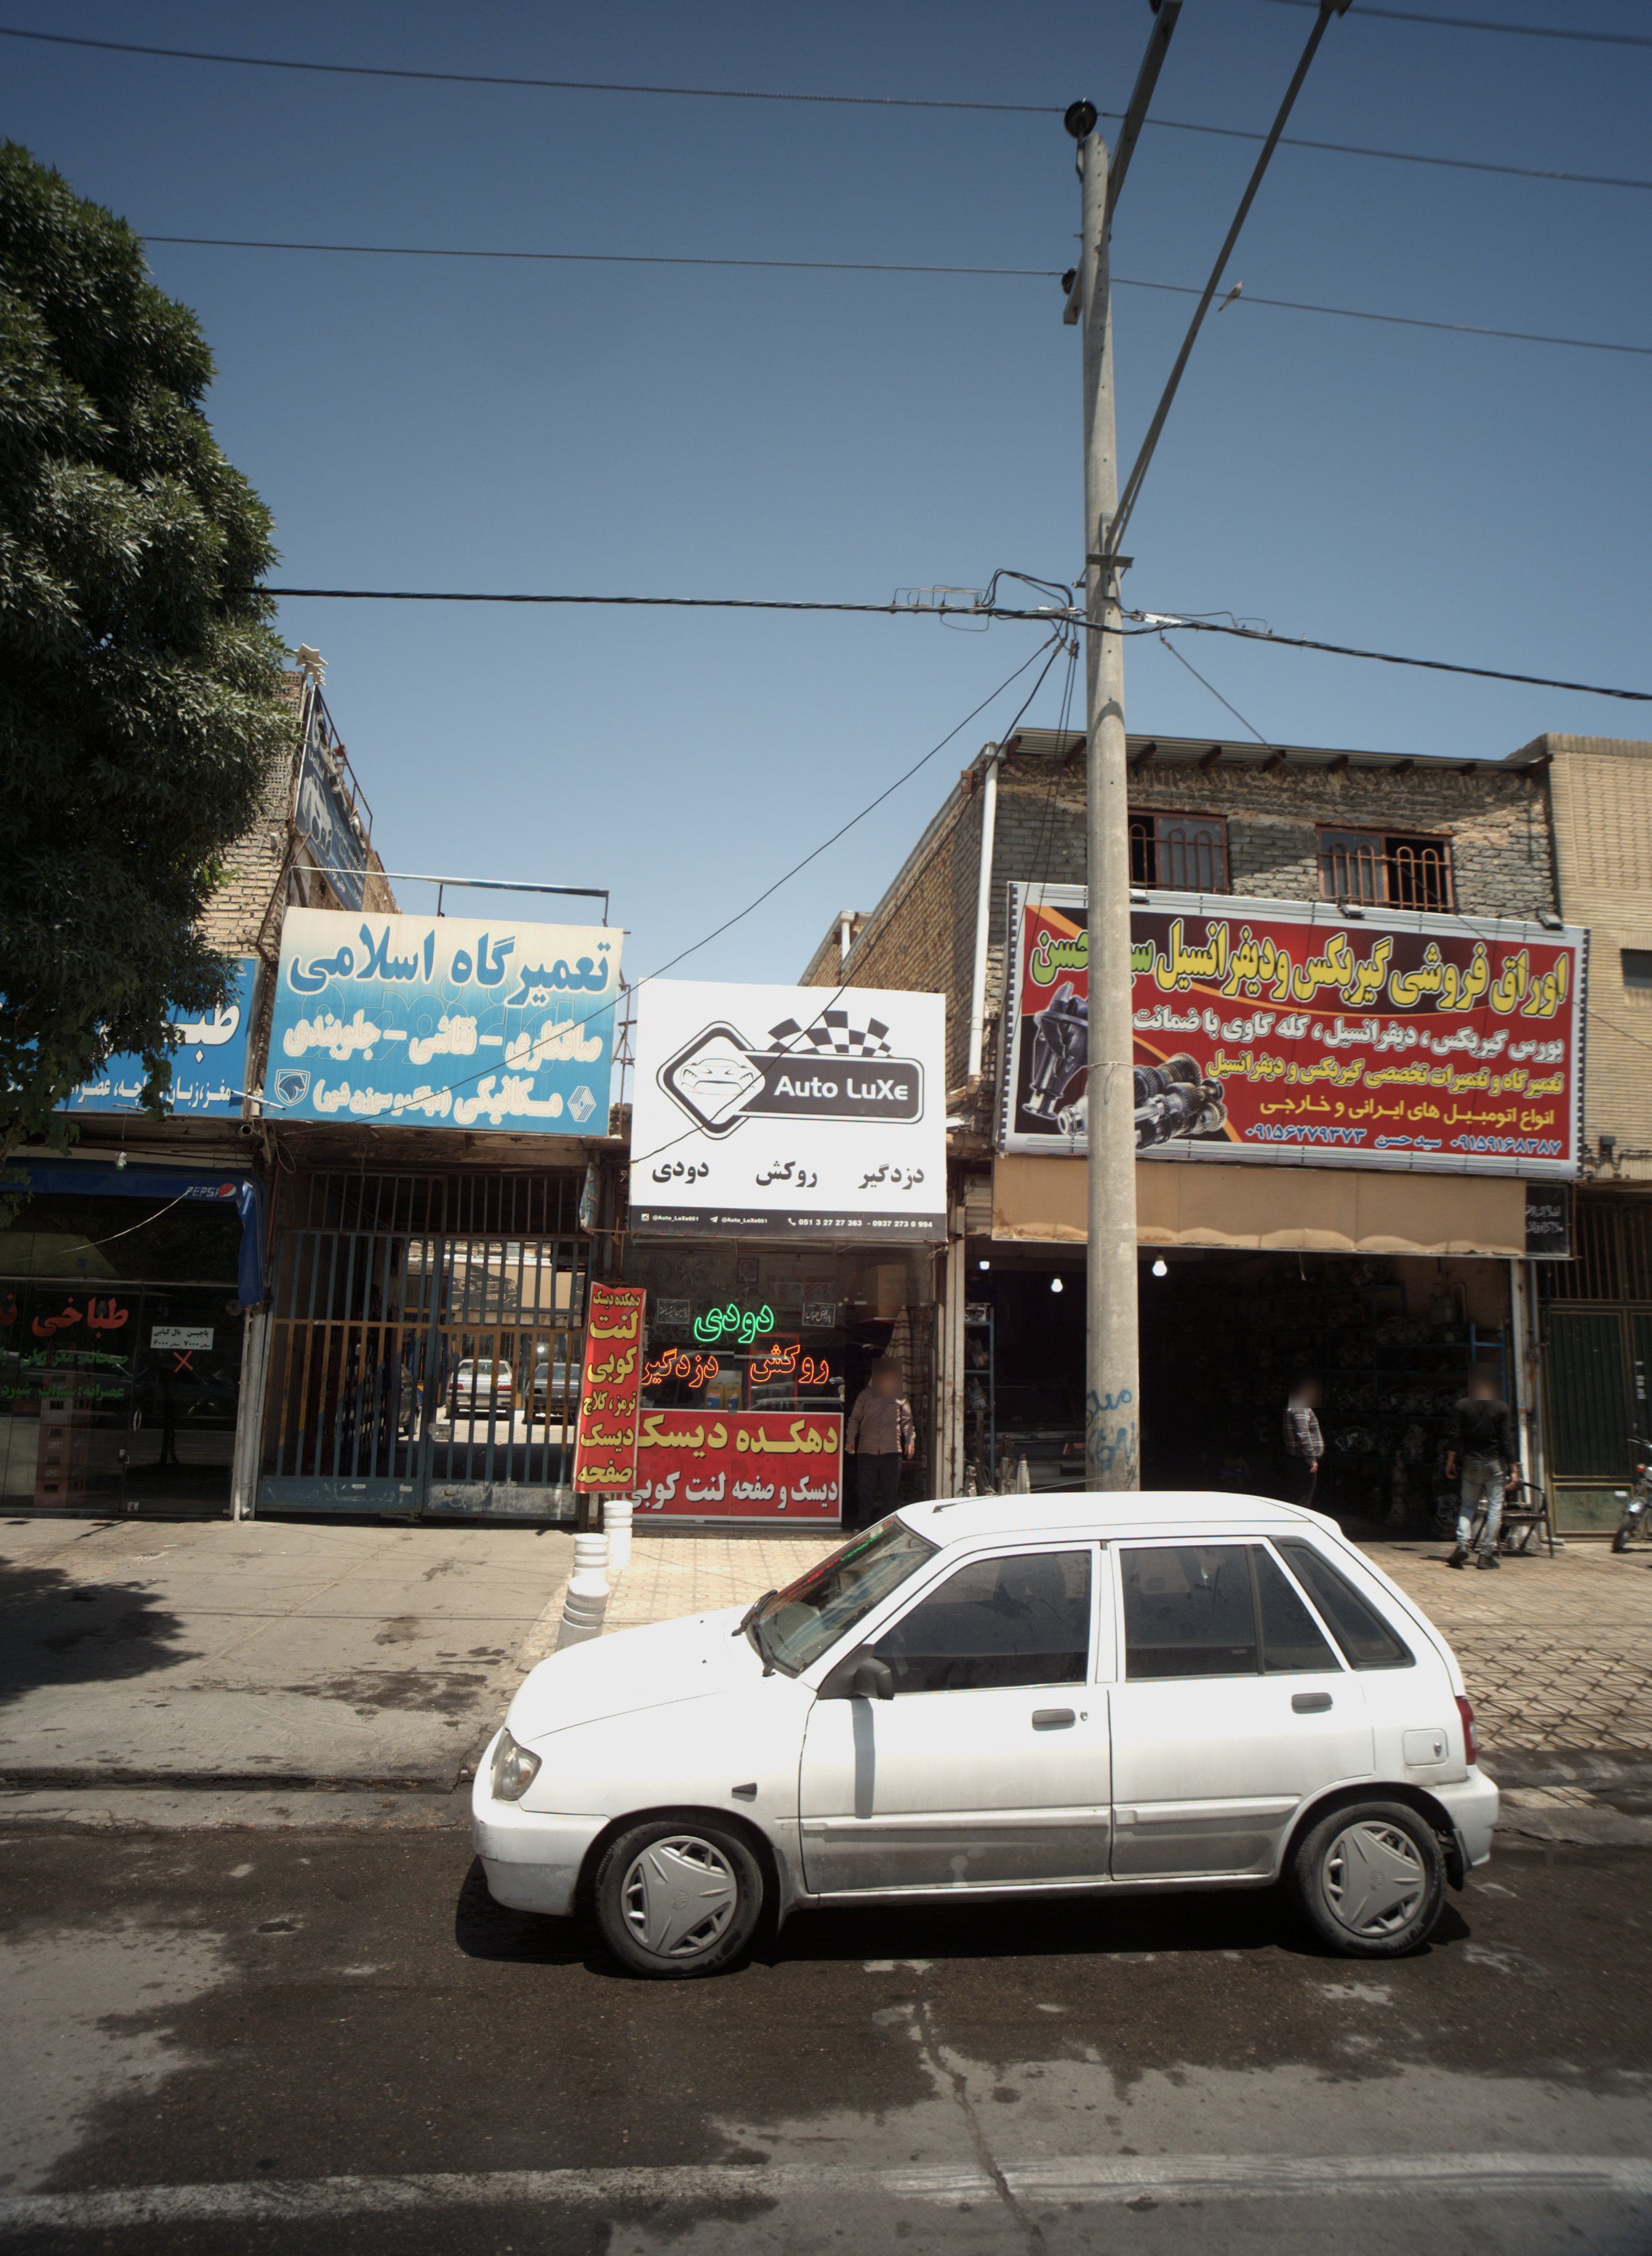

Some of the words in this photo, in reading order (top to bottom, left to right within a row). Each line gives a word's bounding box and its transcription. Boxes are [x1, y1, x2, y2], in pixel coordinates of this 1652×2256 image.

[290, 923, 436, 993] اسلامی
[449, 932, 611, 1007] تعمیرگاه
[1293, 932, 1394, 1005] گیربکس
[1390, 942, 1488, 1010] فروشی
[1491, 950, 1568, 1018] اوراق
[1133, 1005, 1201, 1031] ضمانت
[1203, 1009, 1220, 1039] با
[1222, 1012, 1275, 1042] گاوی
[1277, 1014, 1310, 1038] کله
[284, 1010, 381, 1061] جلوبندی
[409, 1014, 478, 1064] نقاشی
[506, 1019, 603, 1071] صافکاری
[1509, 1039, 1563, 1063] بورس
[1207, 1050, 1285, 1082] دیفرانسیل
[1286, 1063, 1298, 1082] و
[1300, 1057, 1365, 1086] گیربکس
[1365, 1062, 1429, 1088] تخصصی
[1431, 1064, 1490, 1093] تعمیرات
[774, 1076, 838, 1098] Auto
[846, 1078, 909, 1100] LuXe
[1489, 1078, 1499, 1096] و
[1503, 1069, 1564, 1098] تعمیرگاه
[350, 1087, 393, 1114] سوزن
[391, 1094, 404, 1116] و
[454, 1075, 563, 1125] مکانیکی
[1260, 1095, 1331, 1115] خارجی
[1334, 1102, 1345, 1117] و
[1349, 1098, 1404, 1118] ایرانی
[1407, 1102, 1440, 1121] های
[1443, 1104, 1517, 1124] اتومبیل
[1519, 1109, 1555, 1131] انواع
[1375, 1134, 1411, 1148] حسن
[1414, 1136, 1442, 1149] سید
[652, 1160, 709, 1184] دودی
[756, 1160, 818, 1187] روکش
[858, 1163, 925, 1190] دزدگیر
[186, 1186, 220, 1197] PEPSI
[615, 1291, 641, 1308] دهکده
[31, 1296, 129, 1340] طباخی
[589, 1309, 639, 1340] لنت
[694, 1303, 774, 1344] دودی
[587, 1344, 639, 1385] کوبی
[642, 1348, 719, 1388] دزدگیر
[750, 1343, 830, 1385] روکش
[583, 1389, 608, 1417] کلاچ
[580, 1422, 635, 1453] دیسک
[638, 1414, 729, 1458] دیسک
[736, 1419, 839, 1455] دهکده
[577, 1458, 633, 1484] صفحه
[625, 1471, 681, 1511] کوبی
[685, 1471, 727, 1502] لنت
[732, 1474, 775, 1500] صفحه
[778, 1485, 787, 1509] و
[791, 1476, 839, 1508] دیسک
